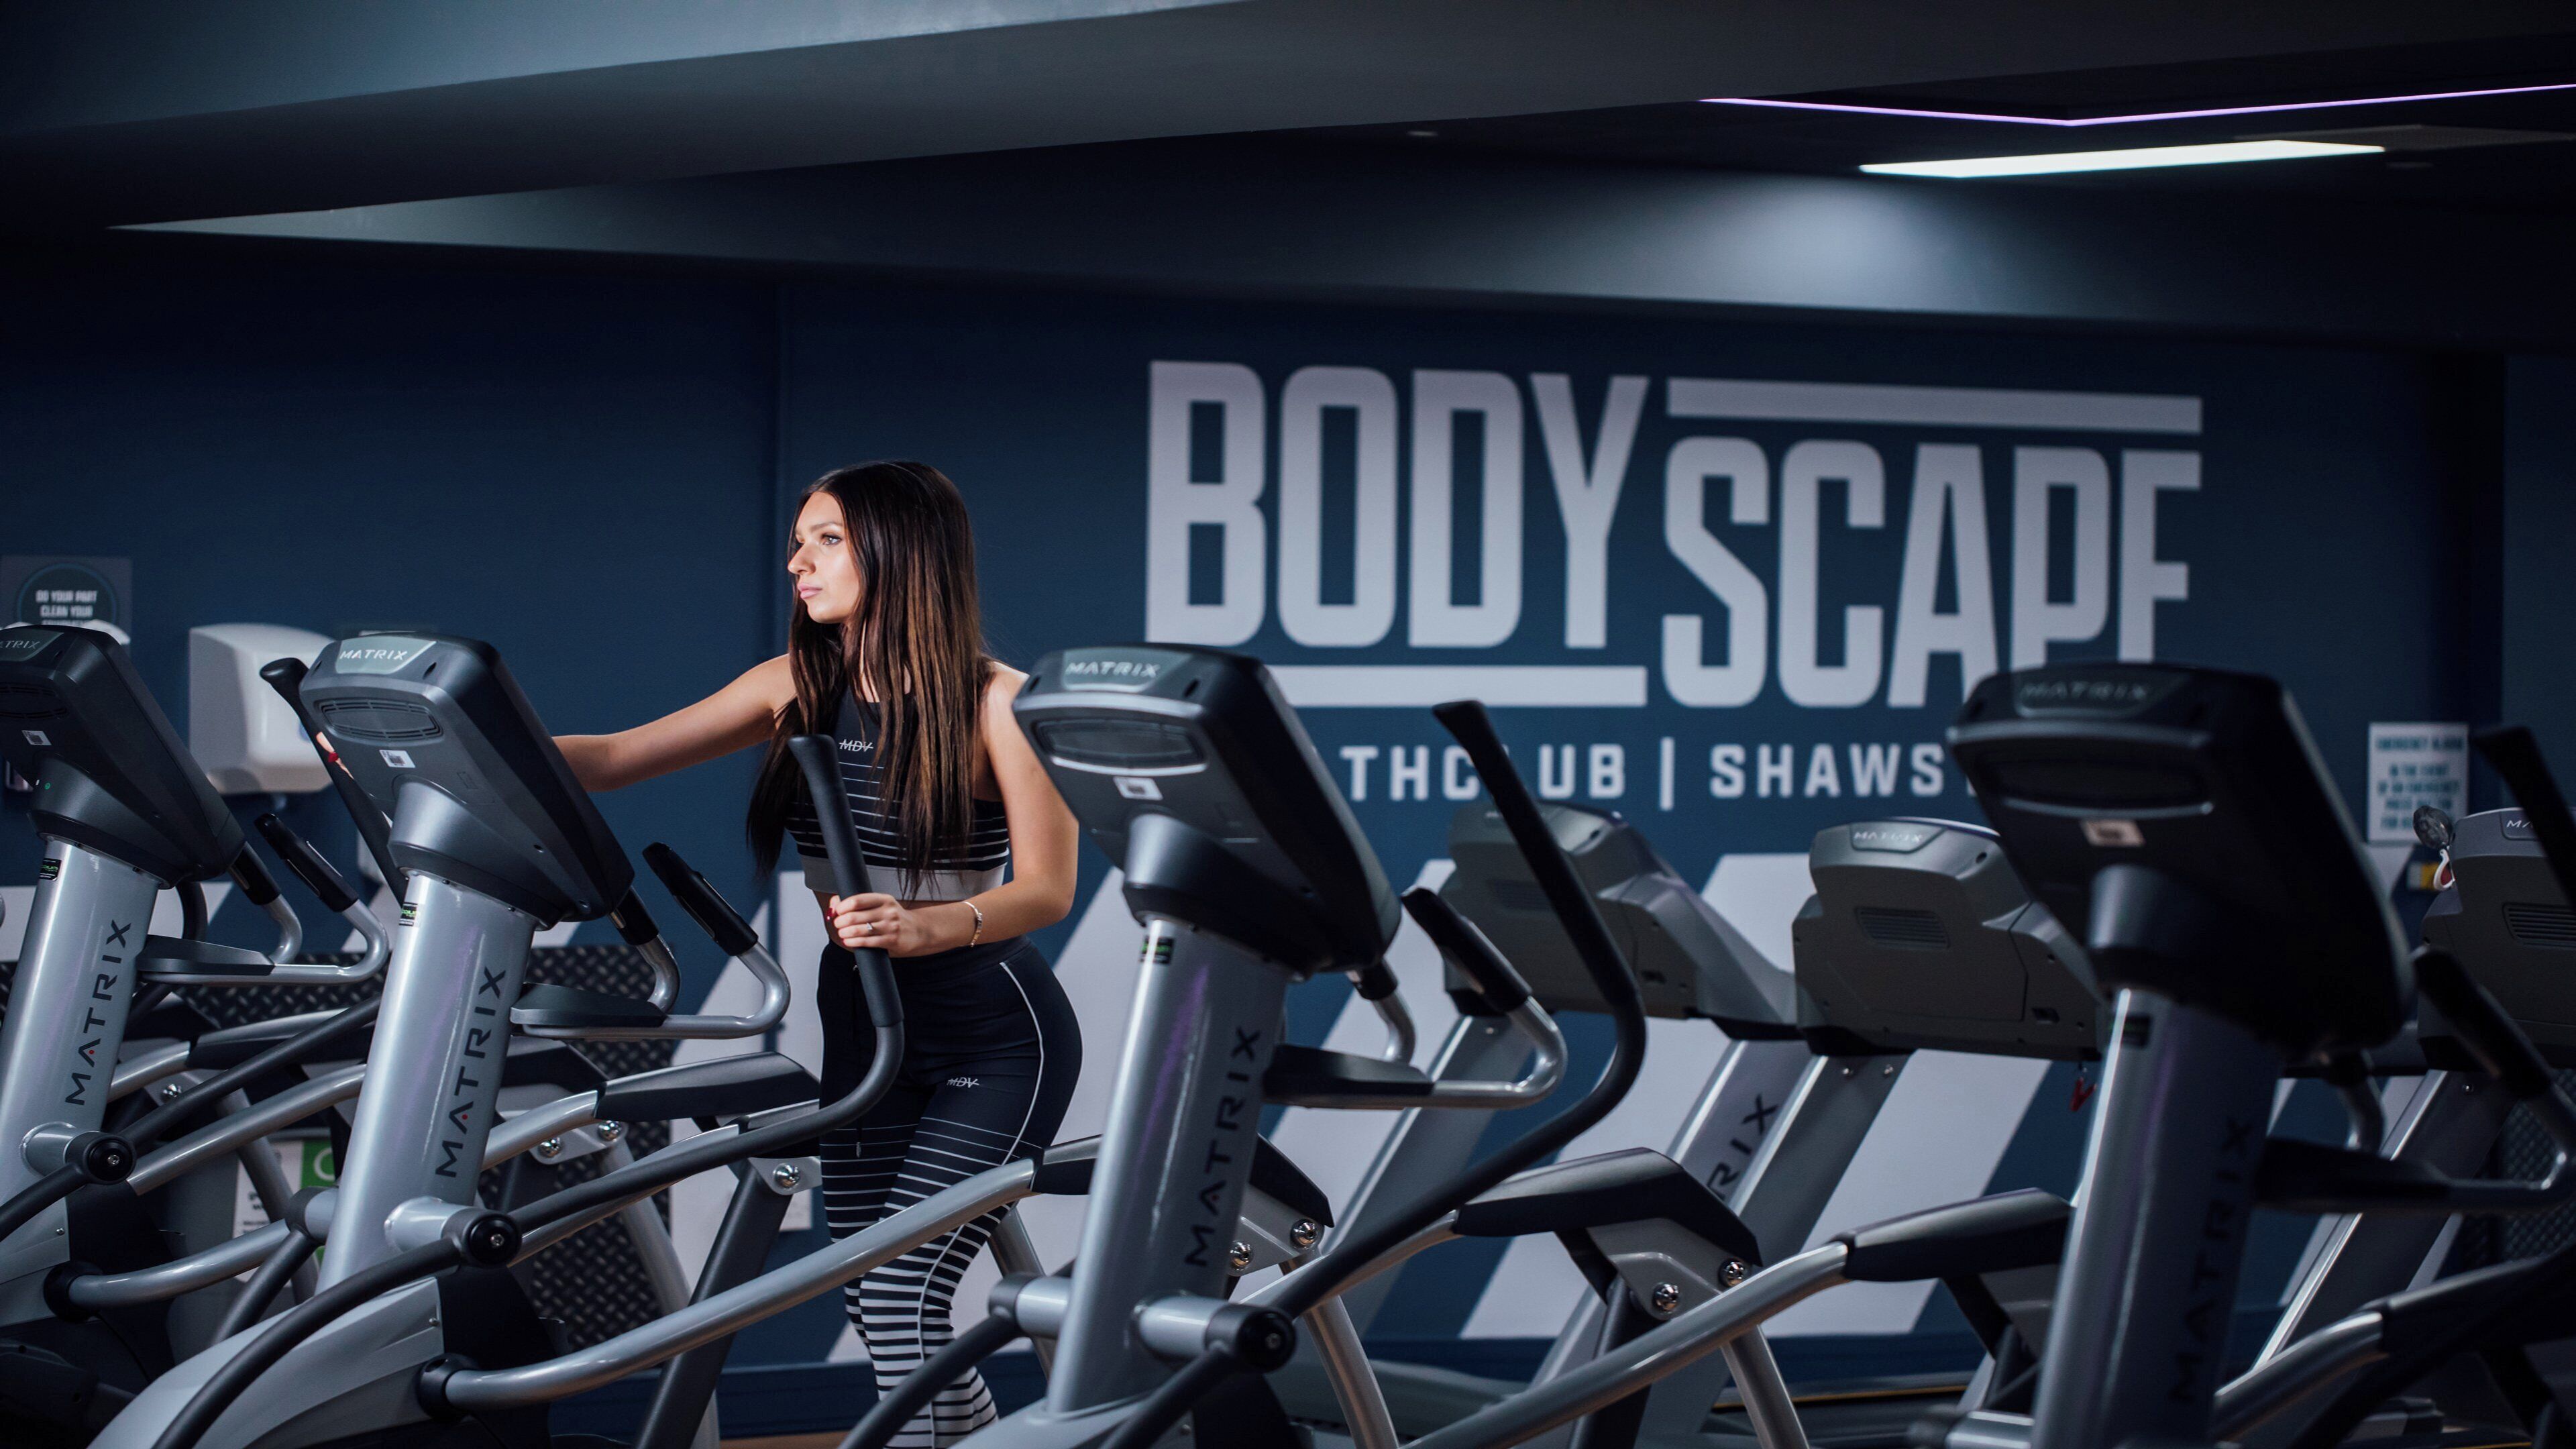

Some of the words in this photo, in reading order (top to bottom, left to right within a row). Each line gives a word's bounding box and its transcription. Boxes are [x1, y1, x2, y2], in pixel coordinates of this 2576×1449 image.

[339, 649, 408, 660] MATRIX
[1065, 661, 1161, 678] MATRIX
[2019, 680, 2147, 700] MATRIX
[839, 739, 873, 752] MDV
[1709, 743, 1976, 798] SHAWS
[65, 920, 131, 1106] MATRIX
[435, 965, 507, 1178] MATRIX
[1185, 1027, 1260, 1267] MATRIX
[2168, 1116, 2252, 1402] MATRIX
